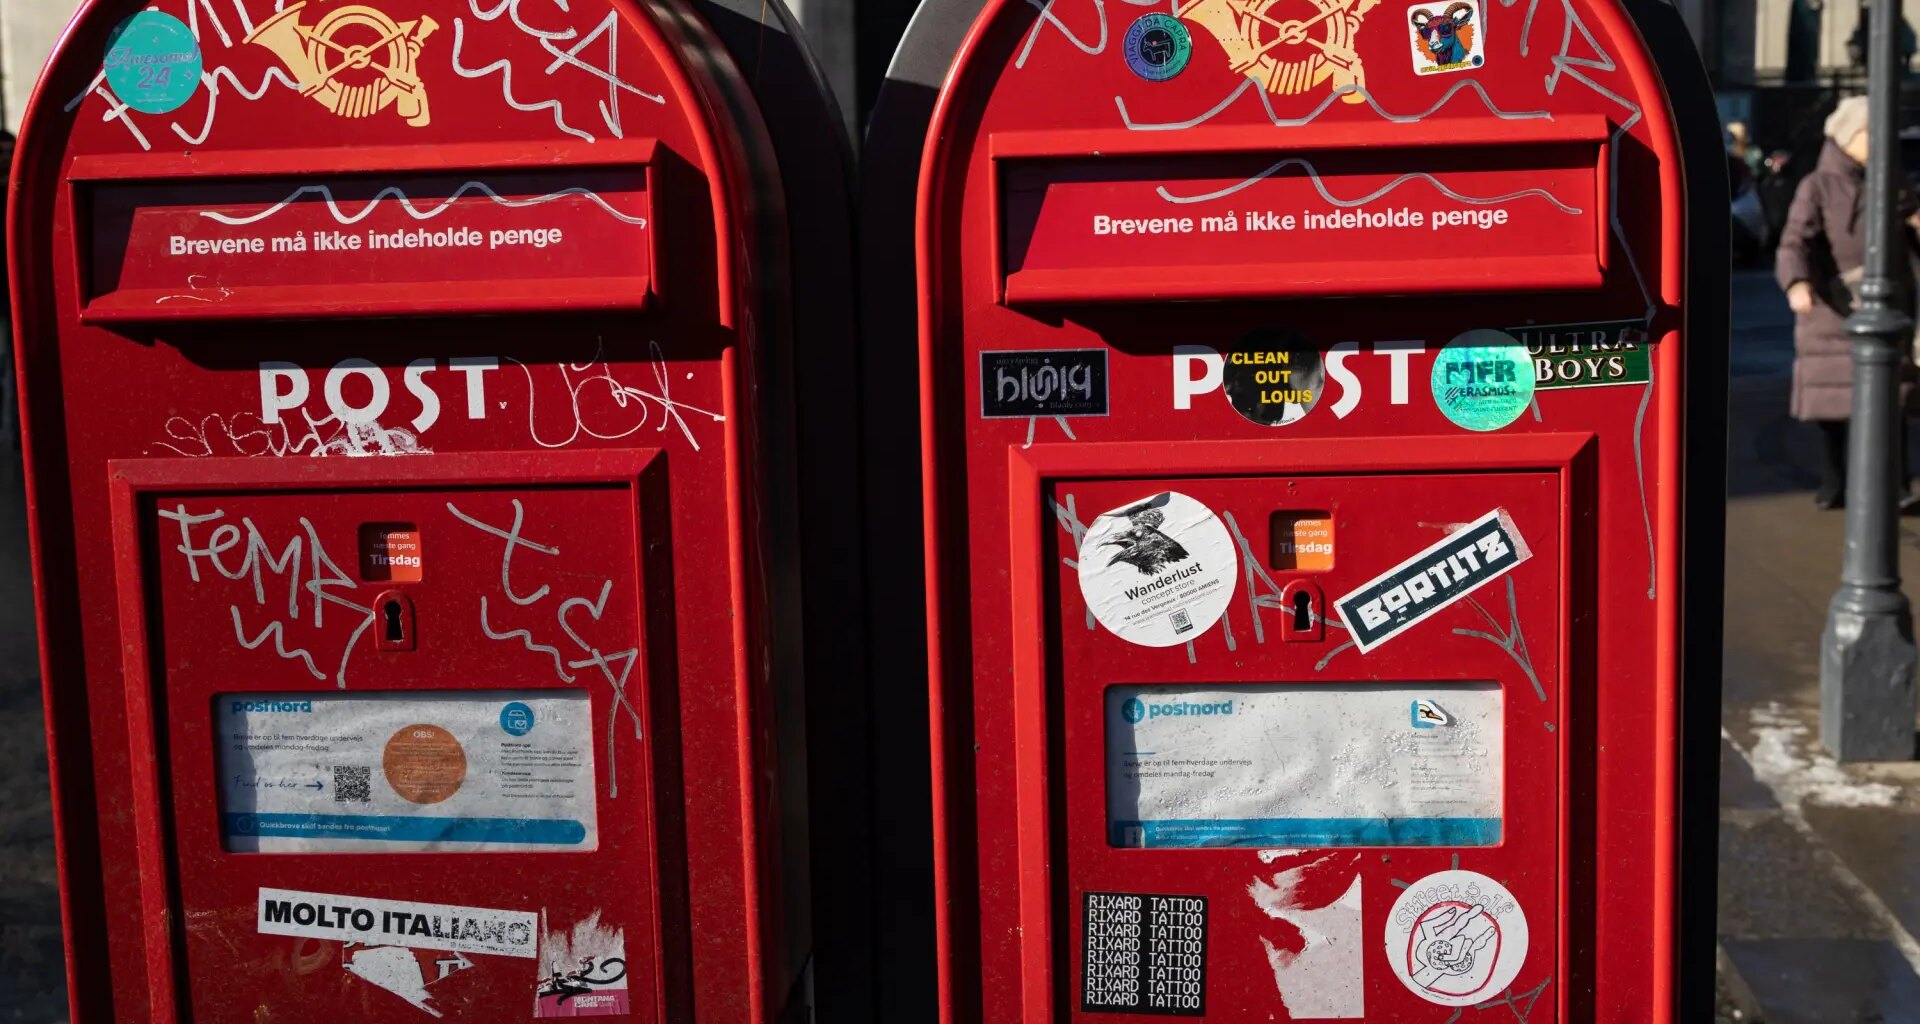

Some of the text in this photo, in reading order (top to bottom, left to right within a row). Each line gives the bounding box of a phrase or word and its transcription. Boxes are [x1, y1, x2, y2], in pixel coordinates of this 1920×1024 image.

[1128, 25, 1144, 64] VIAGGI
[1145, 17, 1160, 28] DA
[1164, 20, 1187, 51] CAPRA
[137, 66, 172, 90] 24
[1093, 207, 1508, 235] Brevene må ikke indeholde penge
[170, 227, 562, 255] Brevene må ikke indeholde penge
[1522, 328, 1637, 355] ULTRA
[1231, 351, 1289, 365] CLEAN
[1255, 370, 1292, 384] OUT
[1536, 356, 1626, 382] BOYS
[1172, 340, 1426, 420] PST
[258, 356, 500, 434] POST
[1261, 390, 1313, 404] LOUIS
[1308, 529, 1328, 538] gang
[1279, 542, 1332, 555] Tirsdag
[370, 554, 420, 567] Tirsdag
[1124, 562, 1203, 601] Wanderlust
[1198, 579, 1220, 591] AMIENS
[1141, 579, 1196, 605] concept store
[232, 700, 312, 714] postnord
[1149, 700, 1233, 719] postnord
[262, 735, 272, 743] op
[296, 734, 328, 743] hverdage
[329, 735, 363, 744] undervejs
[1152, 760, 1162, 768] op
[1186, 759, 1218, 768] hverdage
[1219, 758, 1253, 768] undervejs
[259, 822, 300, 830] Quickbreve
[1089, 895, 1203, 912] RIXARD TATTOO
[1396, 884, 1462, 933] Street
[264, 899, 532, 947] MOLTO ITALIANO
[1089, 909, 1202, 926] RIXARD TATTOO
[1088, 923, 1202, 939] RIXARD TATTOO
[1088, 937, 1201, 953] RIXARD TATTOO
[1088, 950, 1201, 967] RIXARD TATTOO
[1087, 964, 1200, 981] RIXARD TATTOO
[1087, 978, 1200, 994] RIXARD TATTOO
[1087, 992, 1199, 1008] RIXARD TATTOO
